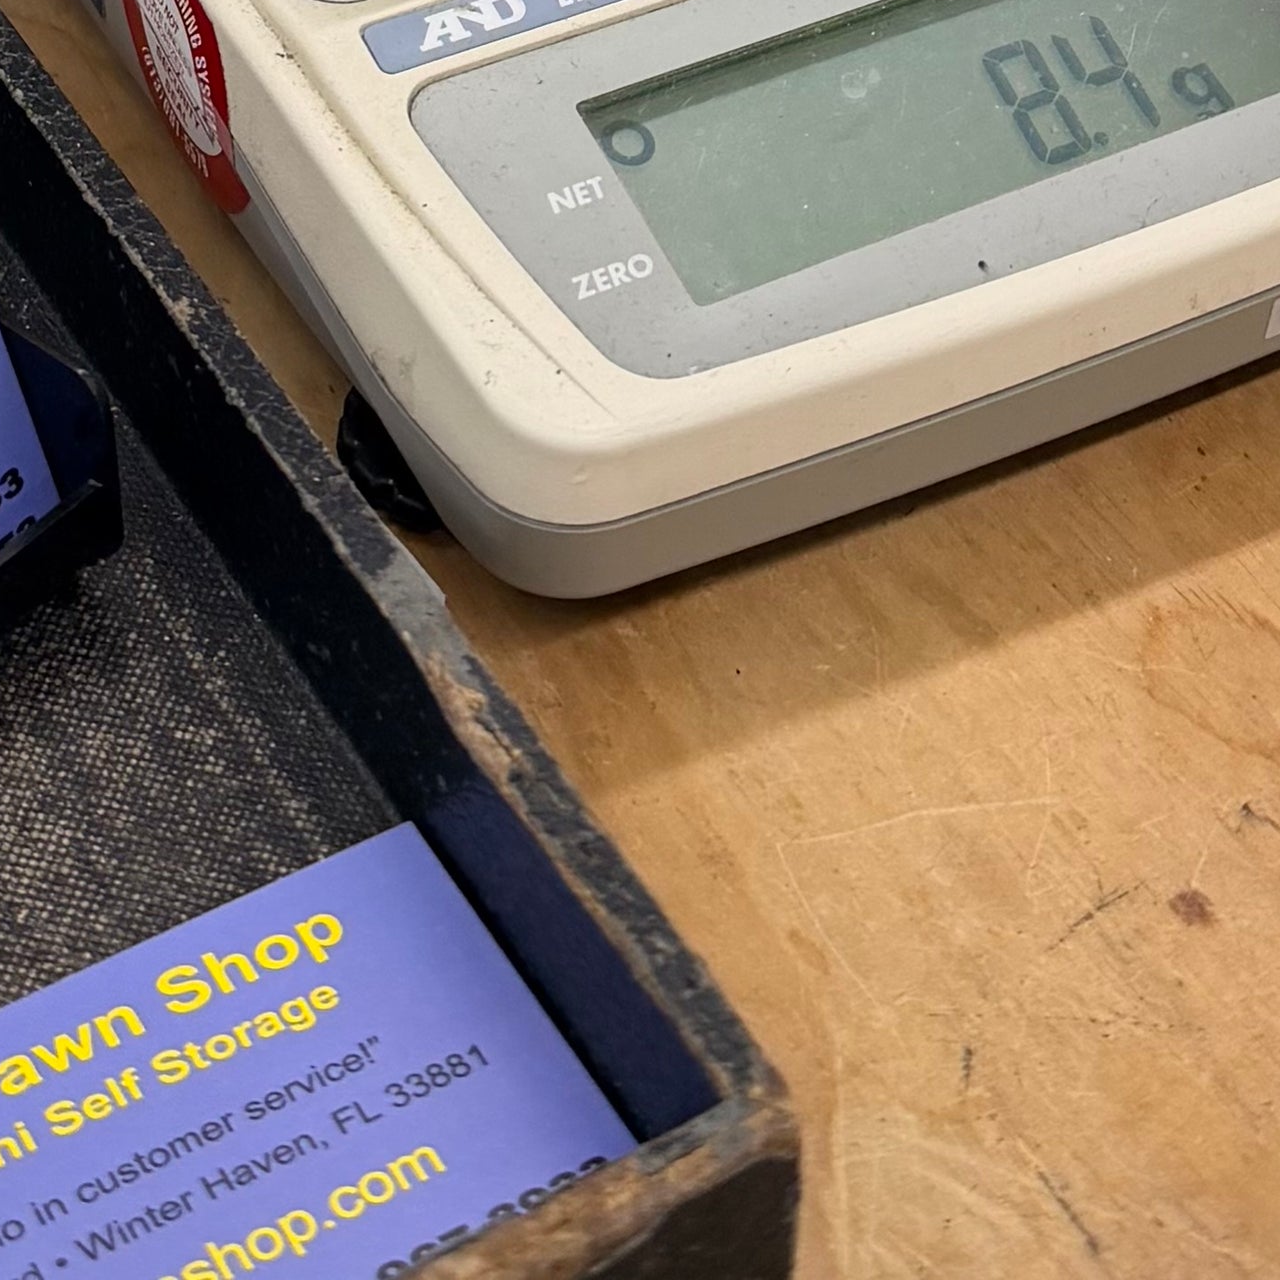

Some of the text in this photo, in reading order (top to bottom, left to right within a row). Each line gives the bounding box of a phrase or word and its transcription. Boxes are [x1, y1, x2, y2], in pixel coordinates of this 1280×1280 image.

[981, 14, 1238, 167] 8.4 g
[546, 174, 606, 216] NET
[571, 251, 655, 303] ZERO
[154, 909, 346, 1020] Shop
[31, 1197, 69, 1226] in
[75, 1111, 235, 1205] customer
[243, 1035, 380, 1122] service!"
[43, 1067, 146, 1140] Self
[149, 978, 341, 1089] Storage
[74, 1043, 491, 1263] Winter Haven, FL 33881
